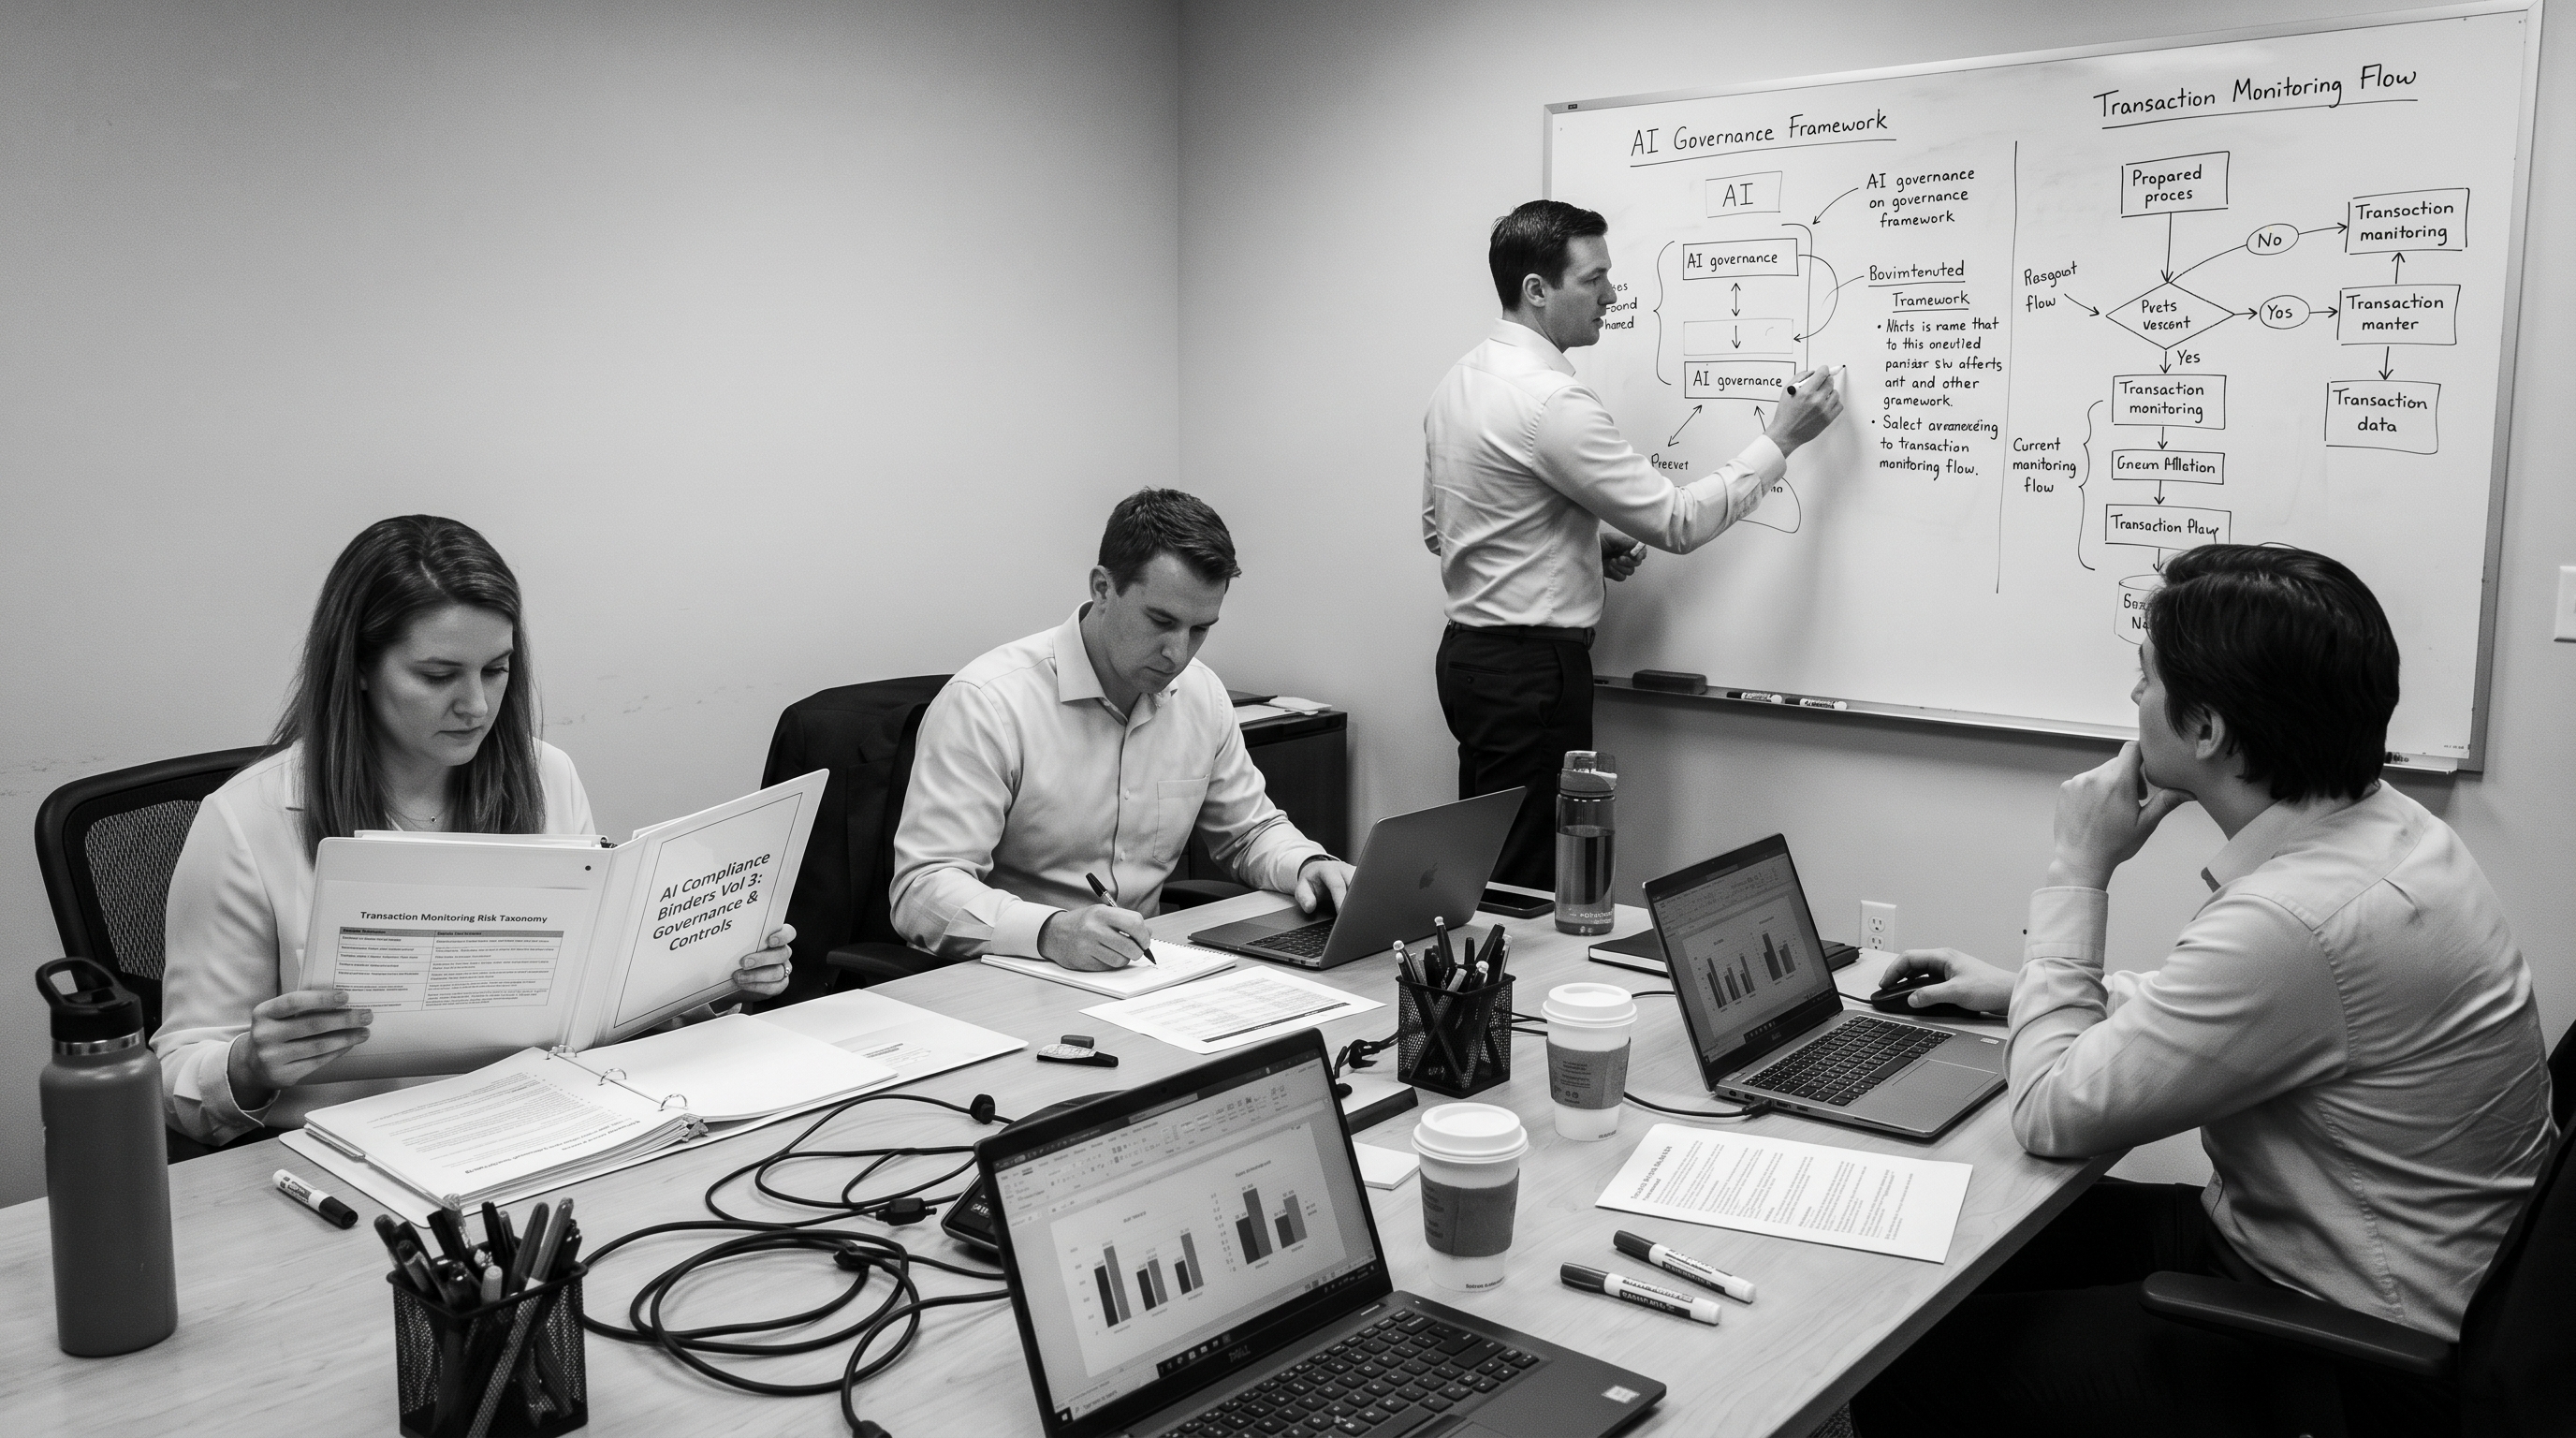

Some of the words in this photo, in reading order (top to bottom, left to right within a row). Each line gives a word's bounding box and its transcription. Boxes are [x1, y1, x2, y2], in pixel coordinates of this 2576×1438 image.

[2094, 88, 2216, 117] Transaction
[2232, 78, 2343, 109] Monitoring
[2361, 64, 2417, 90] Flow
[1631, 128, 1659, 157] AI
[1674, 125, 1775, 151] Governance
[1788, 109, 1888, 139] Framework
[1866, 173, 1886, 189] AI
[1895, 171, 1976, 195] governance
[1721, 182, 1754, 207] AI
[1868, 198, 1886, 209] on
[1892, 190, 1969, 212] governance
[1880, 212, 1955, 230] framework
[2257, 230, 2284, 249] No
[1687, 253, 1703, 270] AI
[1710, 254, 1778, 272] governance
[2026, 295, 2056, 312] flow
[2346, 293, 2444, 309] Transaction
[1923, 322, 1931, 331] is
[1972, 316, 1999, 330] that
[1886, 338, 1896, 350] to
[1903, 337, 1924, 349] this
[2177, 349, 2200, 365] Yes
[1693, 370, 1709, 386] AI
[1718, 376, 1782, 391] governance
[1912, 375, 1935, 389] and
[1942, 376, 1979, 389] other
[2119, 380, 2203, 395] Transaction
[2333, 388, 2427, 409] Transaction
[2129, 402, 2203, 425] monitoring
[2358, 416, 2397, 432] data
[1881, 437, 1893, 449] to
[1898, 437, 1969, 452] transaction
[2013, 437, 2060, 451] Current
[1880, 456, 1939, 481] monitoring
[2025, 477, 2054, 492] flow
[2111, 514, 2181, 533] Transaction
[660, 885, 678, 902] AI
[681, 853, 770, 893] Compliance
[658, 891, 716, 921] Binders
[721, 877, 745, 897] Vol
[748, 873, 763, 887] 3:
[360, 911, 418, 921] Transaction
[420, 913, 476, 923] Monitoring
[500, 915, 548, 923] Taxonomy
[652, 900, 742, 940] Governance
[746, 890, 759, 903] &
[669, 918, 733, 951] Controls
